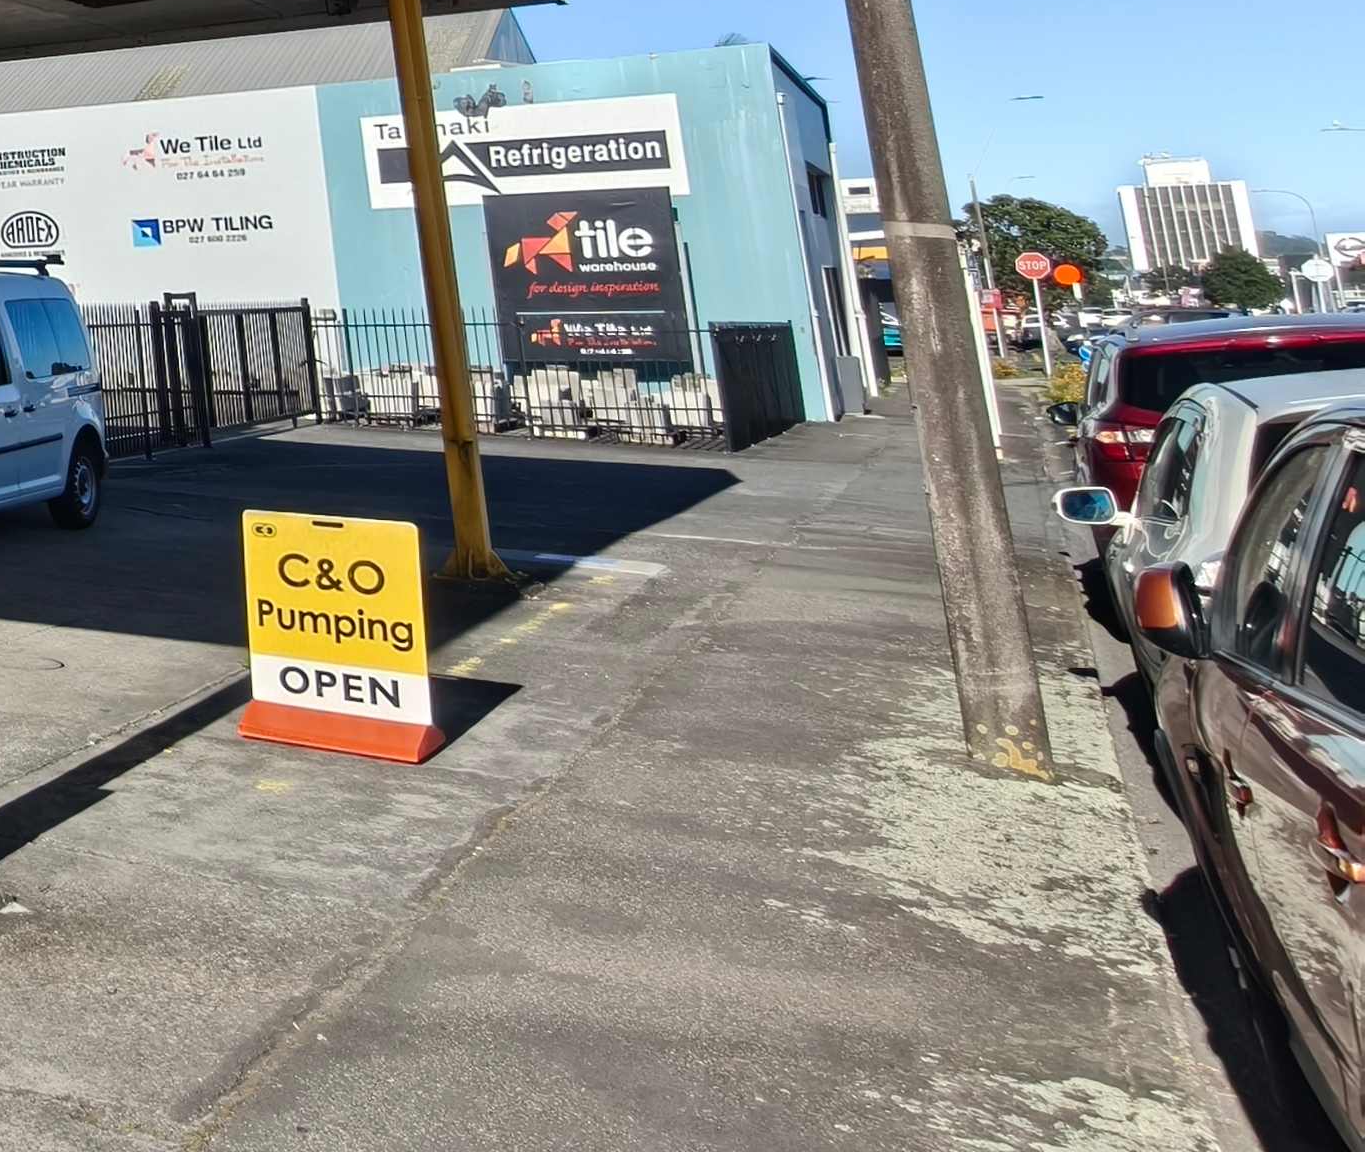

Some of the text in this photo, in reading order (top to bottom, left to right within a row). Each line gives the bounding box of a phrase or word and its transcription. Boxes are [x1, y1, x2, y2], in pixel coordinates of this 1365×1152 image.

[373, 117, 490, 140] Tanaki
[160, 138, 191, 154] We
[195, 135, 231, 152] Tile
[489, 138, 662, 169] Refrigeration
[6, 216, 54, 244] ARDEX
[162, 215, 273, 234] BPW TILING
[574, 219, 653, 259] tile
[579, 262, 657, 272] warehouse
[1019, 260, 1047, 270] STOP
[527, 280, 660, 298] for design inspiration
[278, 553, 385, 596] C&O
[257, 599, 414, 652] Pumping
[279, 666, 401, 708] OPEN
